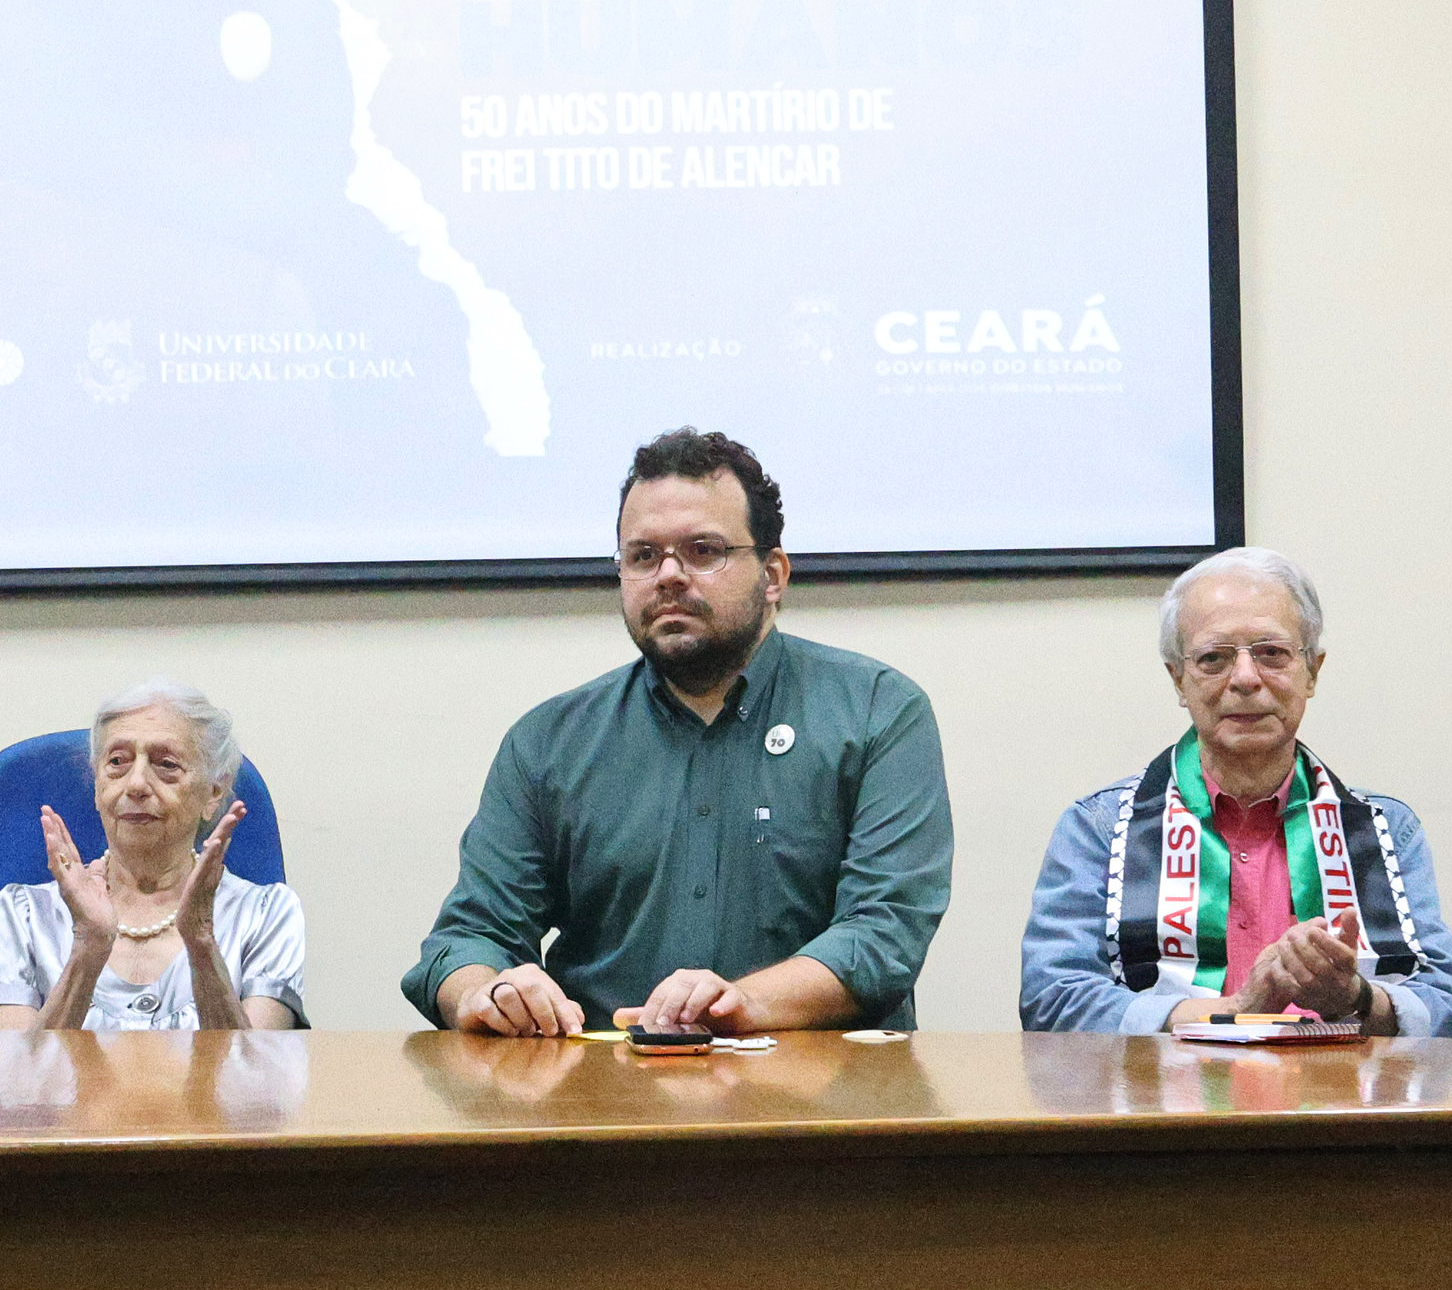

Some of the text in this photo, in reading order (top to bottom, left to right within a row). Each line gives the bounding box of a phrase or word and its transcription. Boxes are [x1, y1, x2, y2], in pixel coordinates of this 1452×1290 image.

[461, 80, 894, 137] 50 ANOS DO MARTÍRIO DE
[461, 141, 841, 193] FREI TITO DE ALENCAR
[873, 293, 1121, 354] CEARÁ
[589, 338, 741, 361] REALIZAÇÃO
[875, 357, 1123, 376] GOVERNO DO ESTADO
[159, 359, 278, 383] FEDERAL
